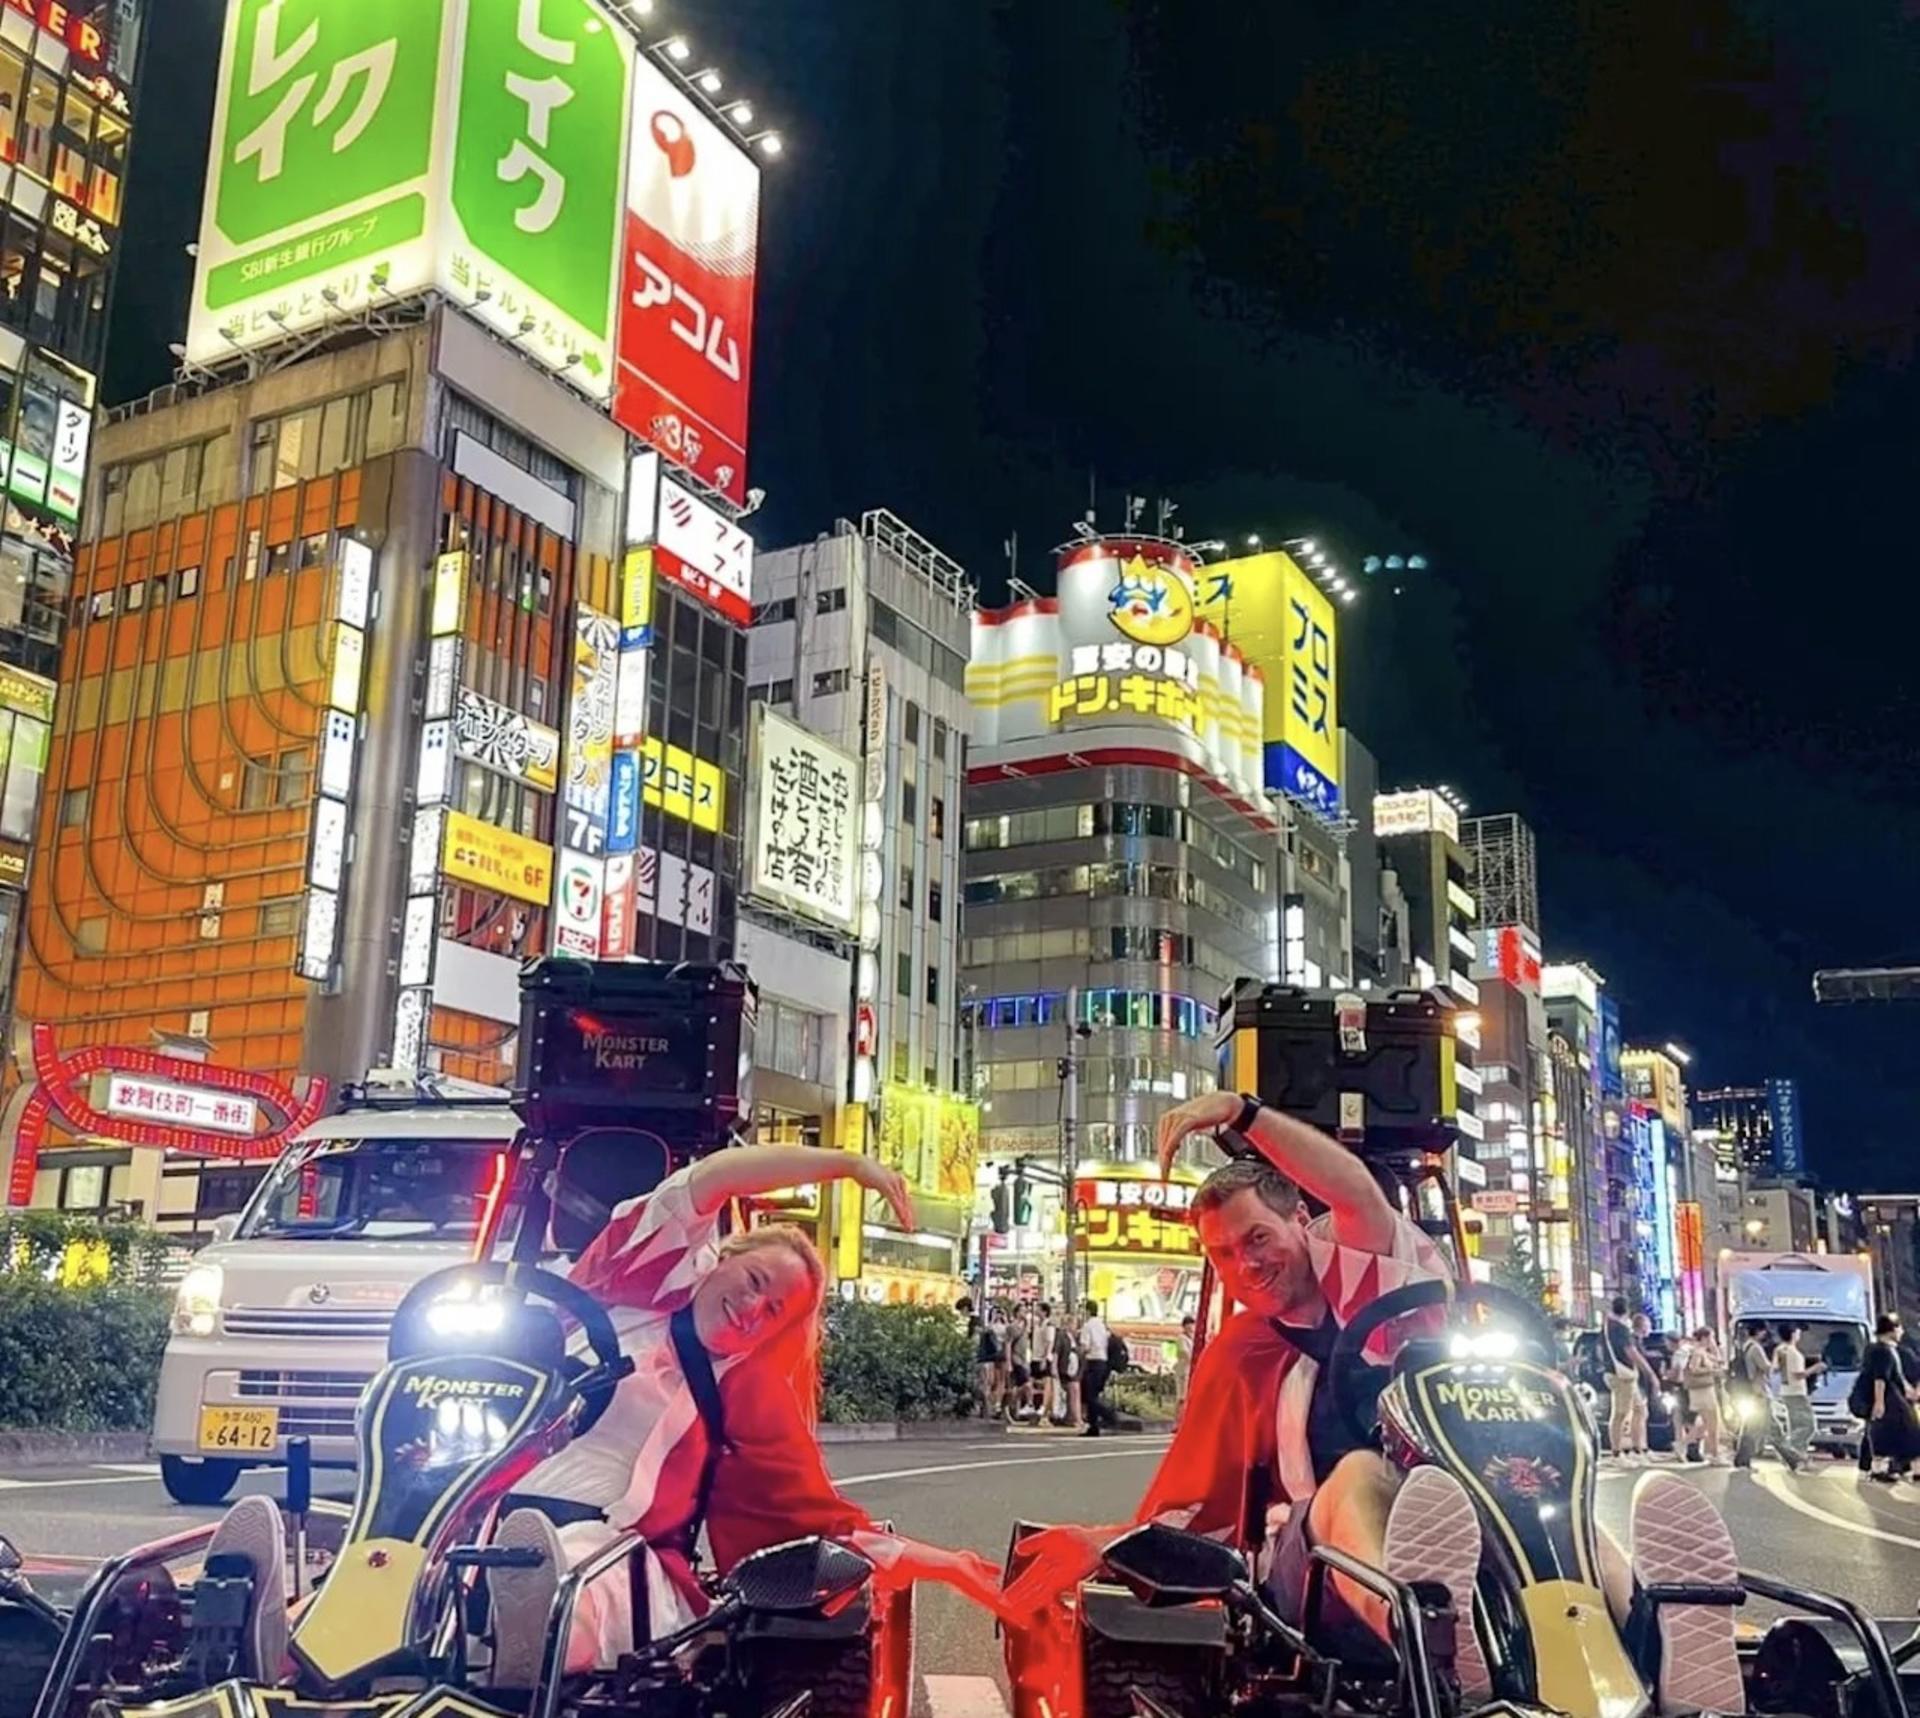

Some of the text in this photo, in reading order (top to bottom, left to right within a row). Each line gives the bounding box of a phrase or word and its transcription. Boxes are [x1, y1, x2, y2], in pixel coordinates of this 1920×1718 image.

[234, 0, 398, 182] レイク
[497, 0, 575, 233] レイク
[632, 252, 740, 382] アコム
[1290, 597, 1331, 746] プロミス
[568, 808, 604, 853] 7F
[523, 865, 545, 888] 6F
[583, 1033, 669, 1053] MONSTER
[595, 1049, 646, 1068] KART
[117, 1084, 249, 1126] 歌舞伎町一番街
[403, 1375, 524, 1398] MONSTER
[416, 1392, 492, 1411] KRT
[1460, 1400, 1533, 1422] KART
